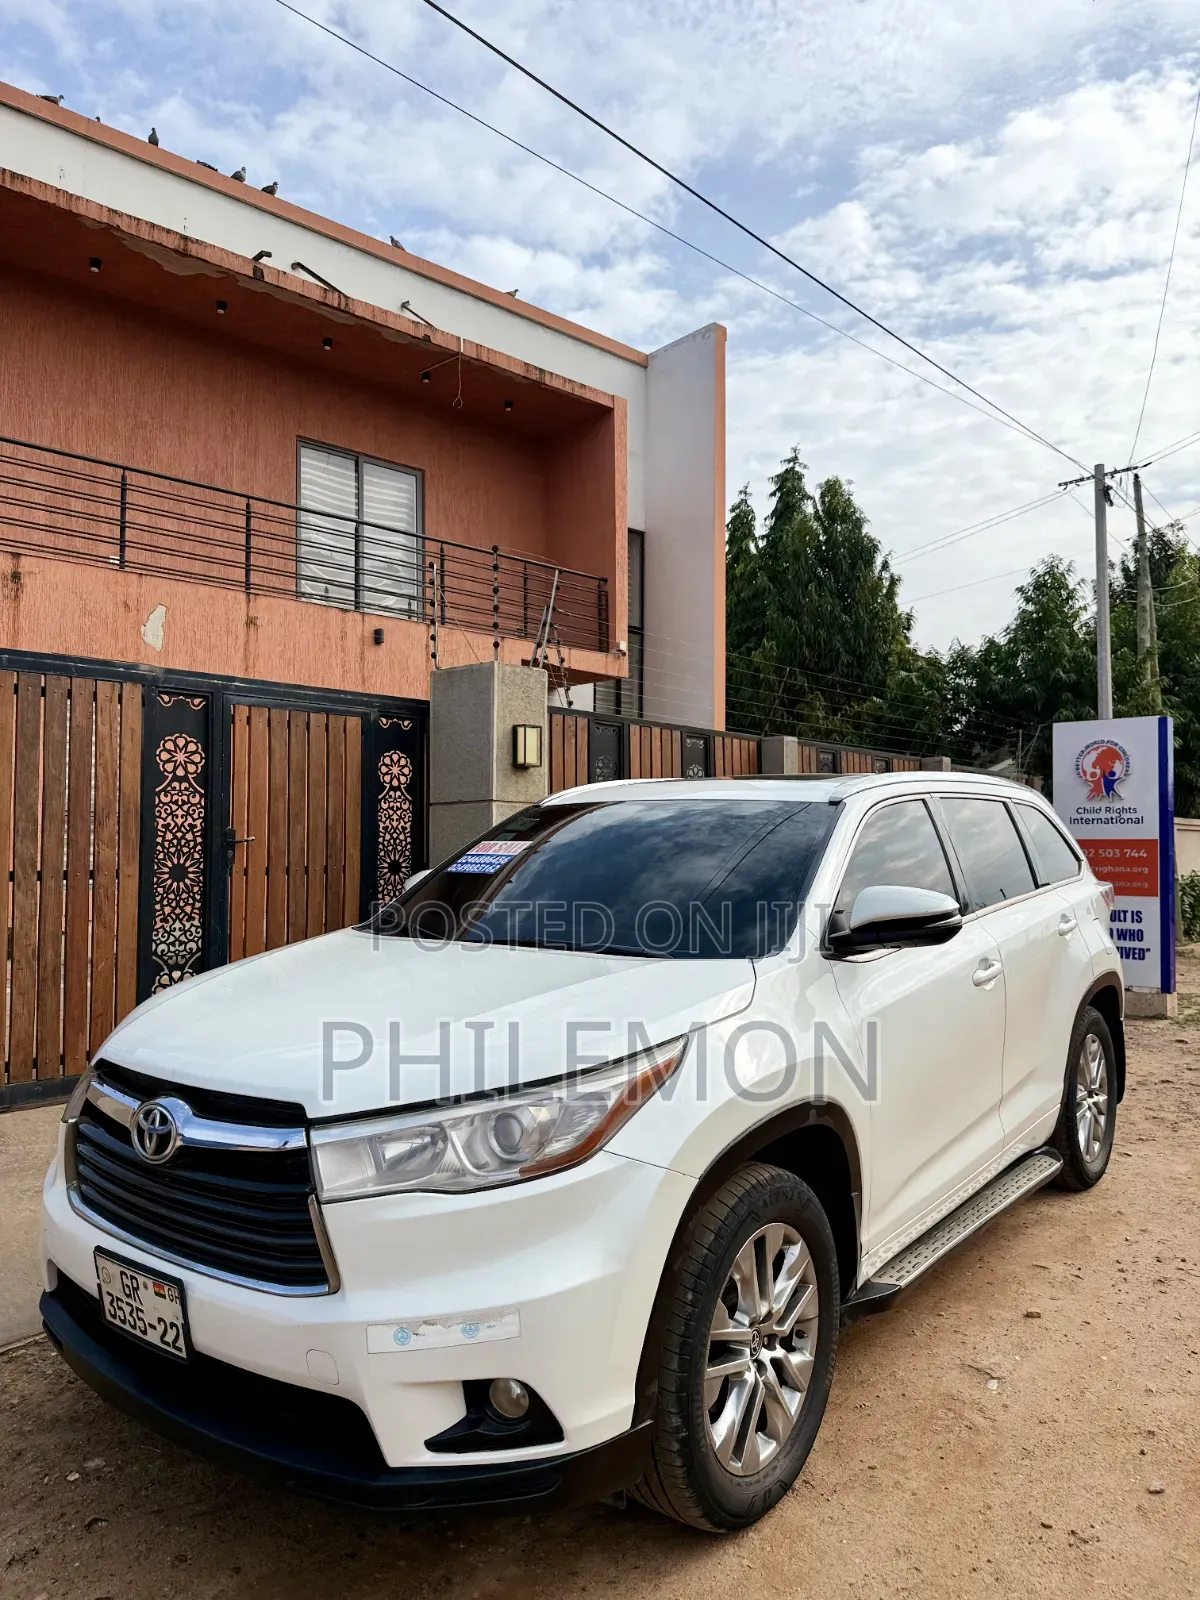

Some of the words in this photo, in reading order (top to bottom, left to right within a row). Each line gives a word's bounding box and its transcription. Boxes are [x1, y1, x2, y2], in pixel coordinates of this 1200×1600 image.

[1084, 739, 1106, 751] WORLD
[1106, 739, 1119, 748] FOR
[1118, 746, 1131, 774] CHILDREN
[1076, 806, 1102, 815] Child
[1105, 806, 1138, 818] Rights
[1069, 816, 1144, 826] International
[469, 842, 498, 854] FOR
[493, 842, 527, 854] SALE
[1098, 849, 1121, 858] 503
[1123, 849, 1148, 858] 744
[1131, 910, 1143, 923] IS
[1116, 928, 1144, 942] WHO
[120, 1270, 144, 1305] GR
[106, 1291, 183, 1353] 3535-22
